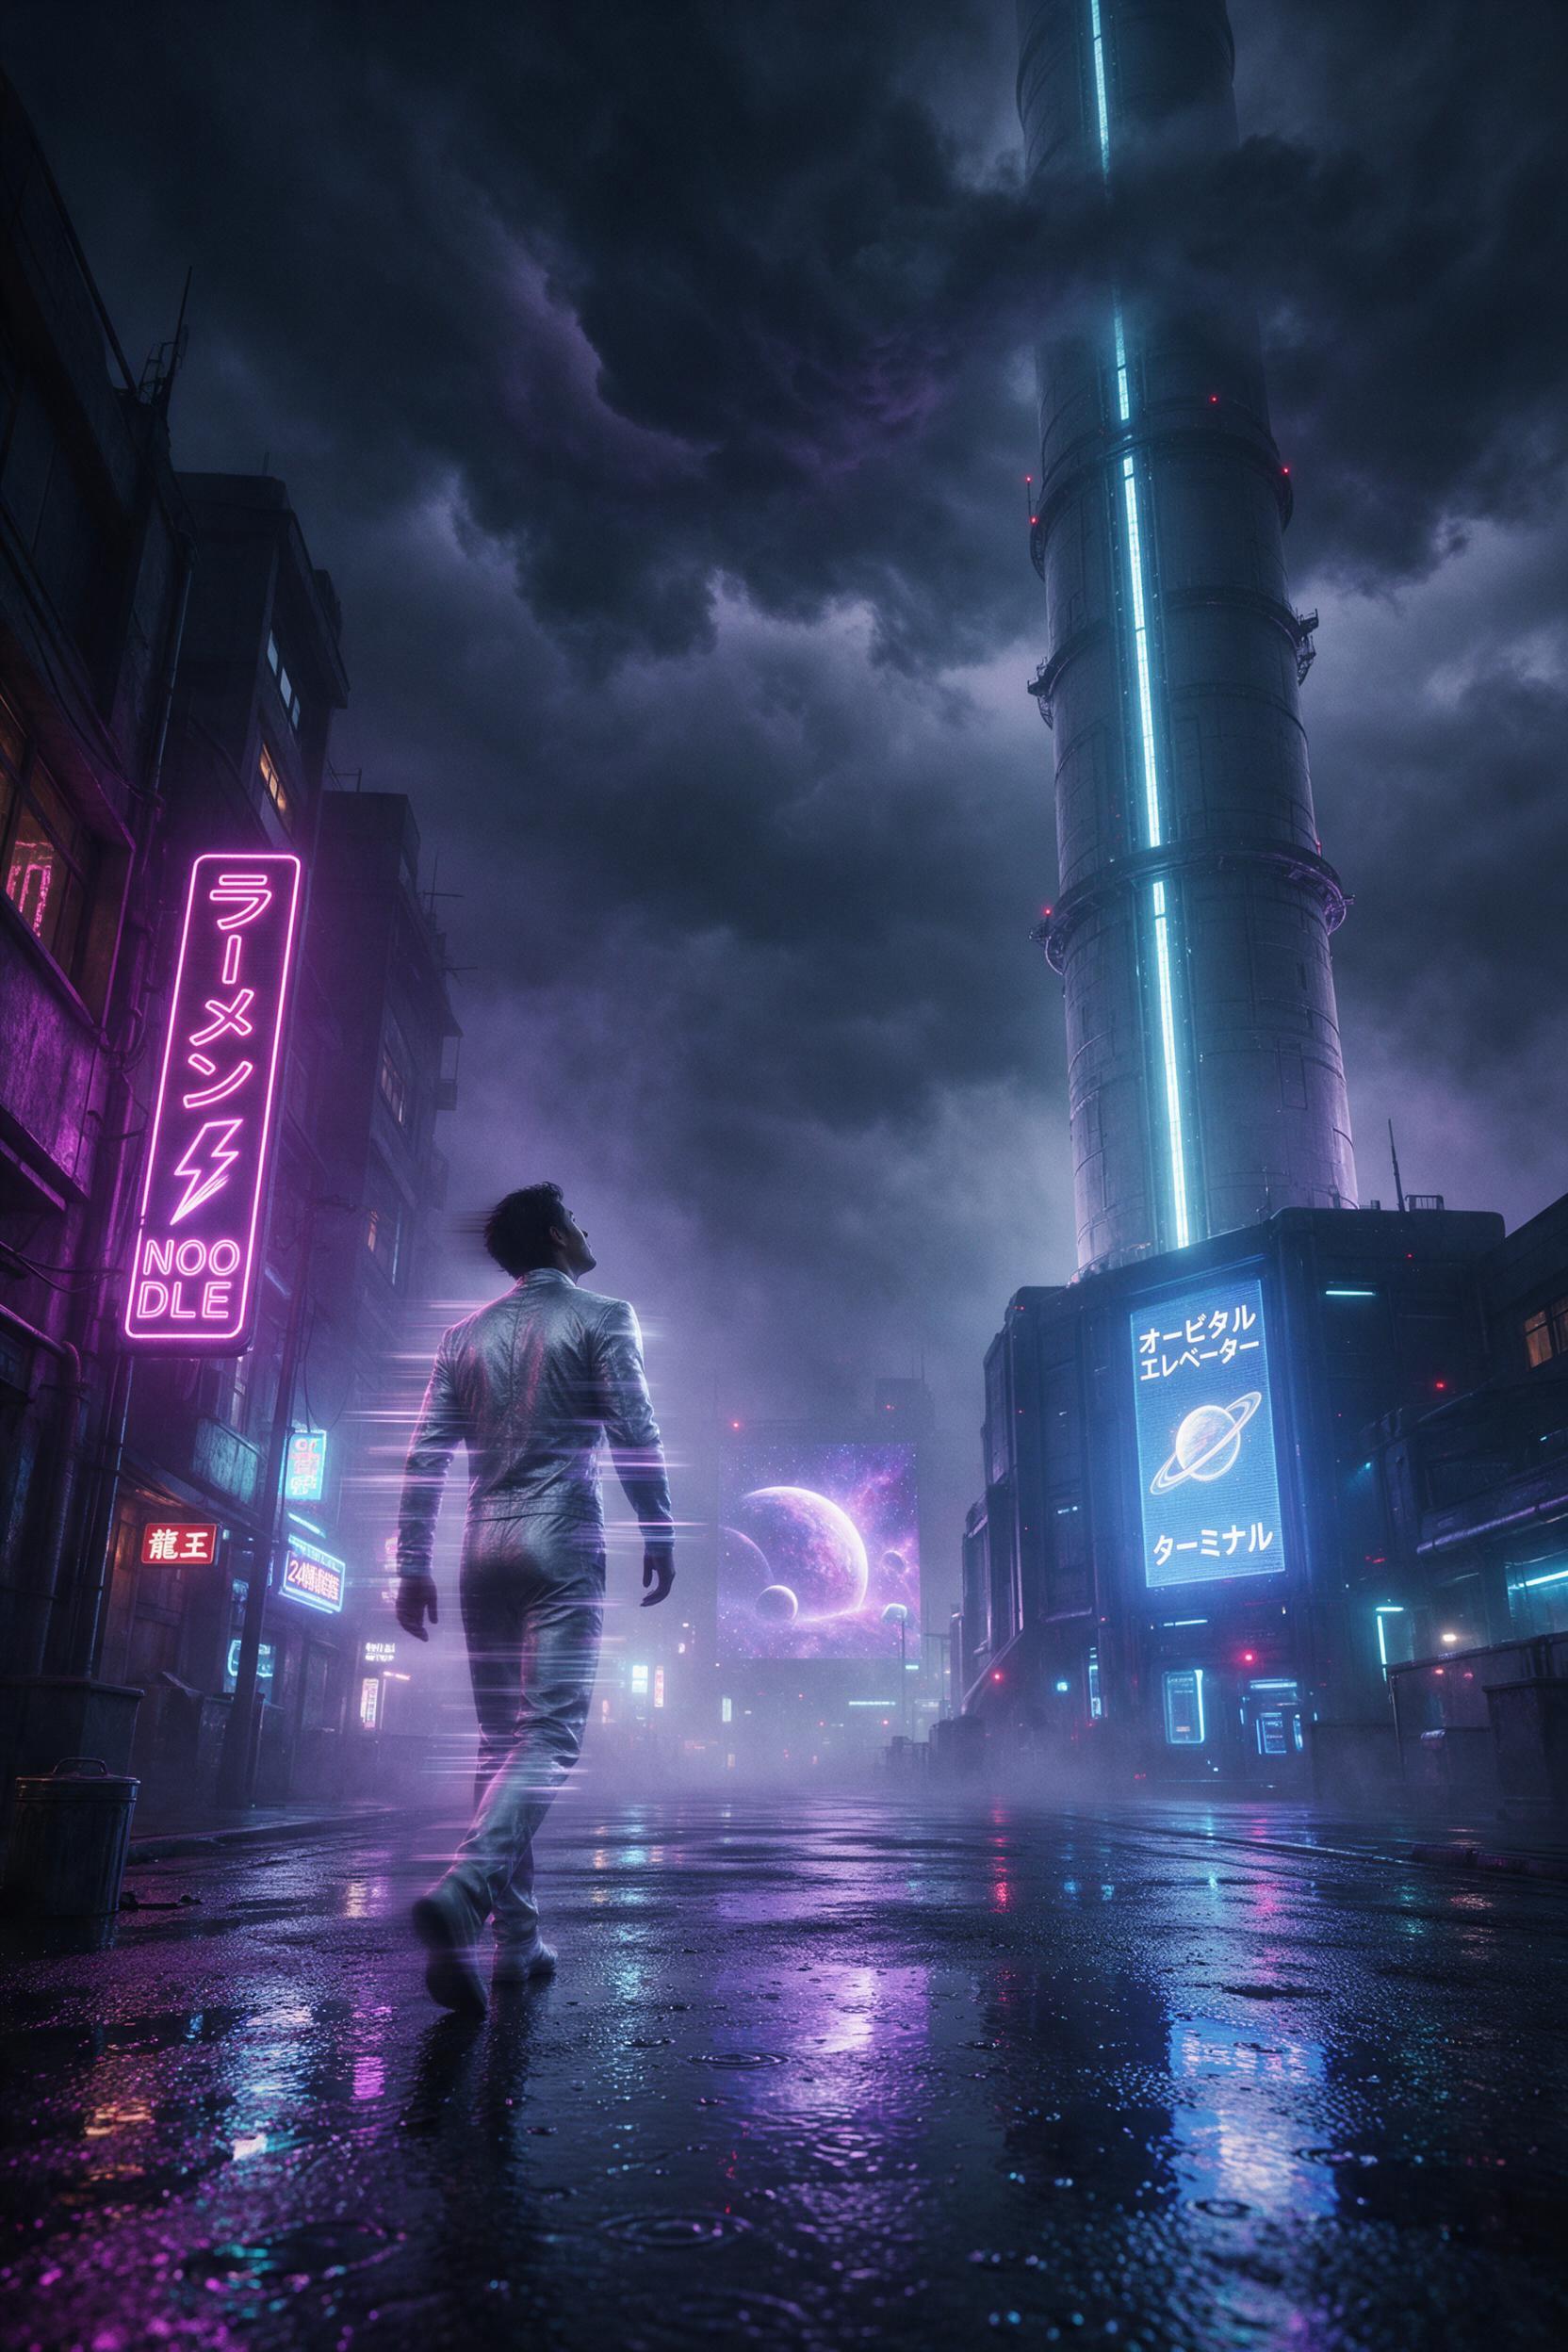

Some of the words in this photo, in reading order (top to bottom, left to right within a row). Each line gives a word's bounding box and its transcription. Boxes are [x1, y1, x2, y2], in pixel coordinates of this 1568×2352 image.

[183, 874, 271, 1108] ラーメン
[143, 1239, 240, 1276] NOO
[137, 1281, 232, 1319] DLE
[1139, 1305, 1256, 1354] オービタル
[1140, 1338, 1259, 1380] エレベーター
[149, 1528, 208, 1560] 龍王
[1153, 1522, 1273, 1566] ターミナル
